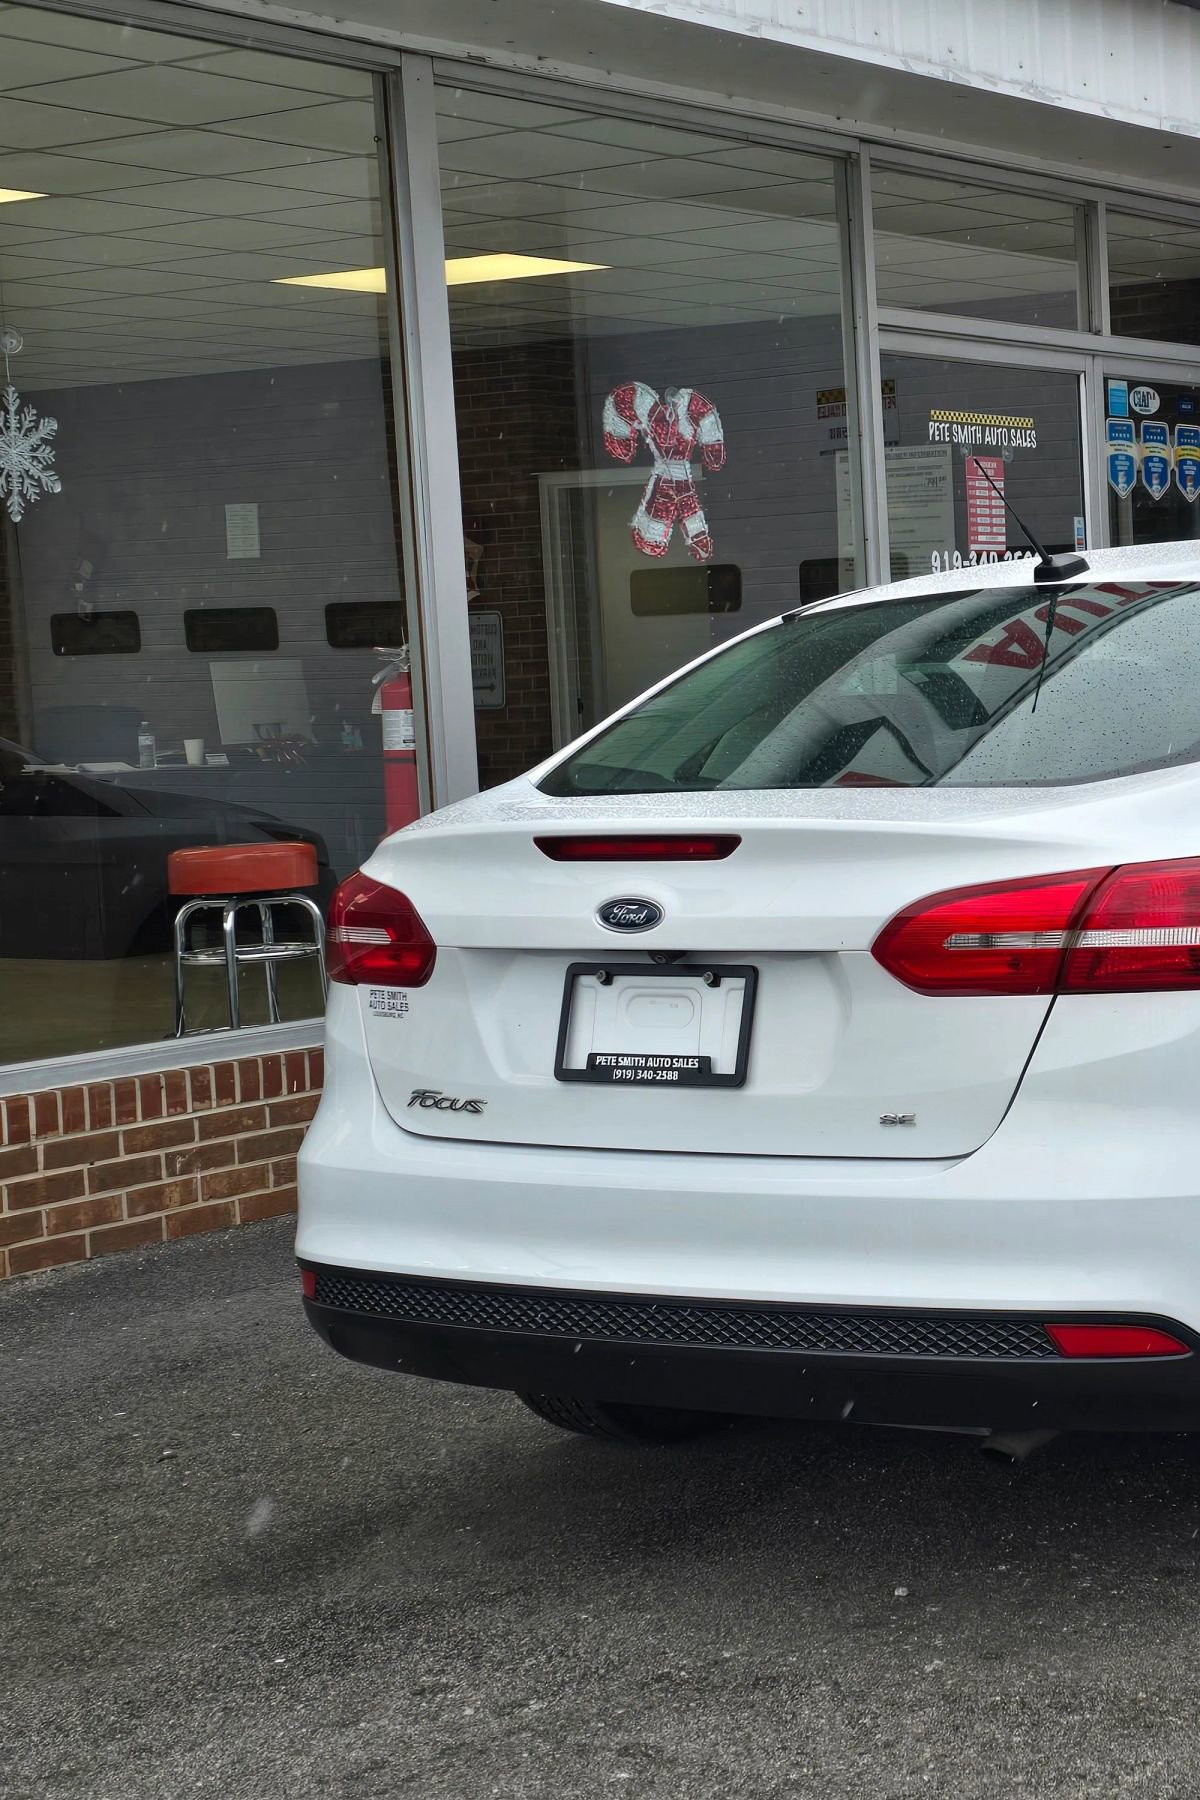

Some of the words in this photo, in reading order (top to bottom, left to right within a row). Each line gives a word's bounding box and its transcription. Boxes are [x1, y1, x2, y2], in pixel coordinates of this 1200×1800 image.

[929, 422, 950, 441] PETE
[952, 424, 982, 444] SMITH
[984, 426, 1008, 446] AUTO
[1010, 428, 1037, 448] SALES
[610, 904, 648, 923] Ford
[370, 990, 386, 1000] PETE
[387, 991, 407, 1001] SMITH
[370, 1000, 386, 1010] AUTO
[388, 1002, 408, 1012] SALES
[596, 1056, 617, 1066] PETE
[618, 1056, 646, 1067] SMITH
[646, 1058, 671, 1068] AUTO
[672, 1058, 699, 1068] SALES
[613, 1069, 634, 1080] (919)
[636, 1070, 678, 1080] 340-2588
[880, 1113, 916, 1127] SE
